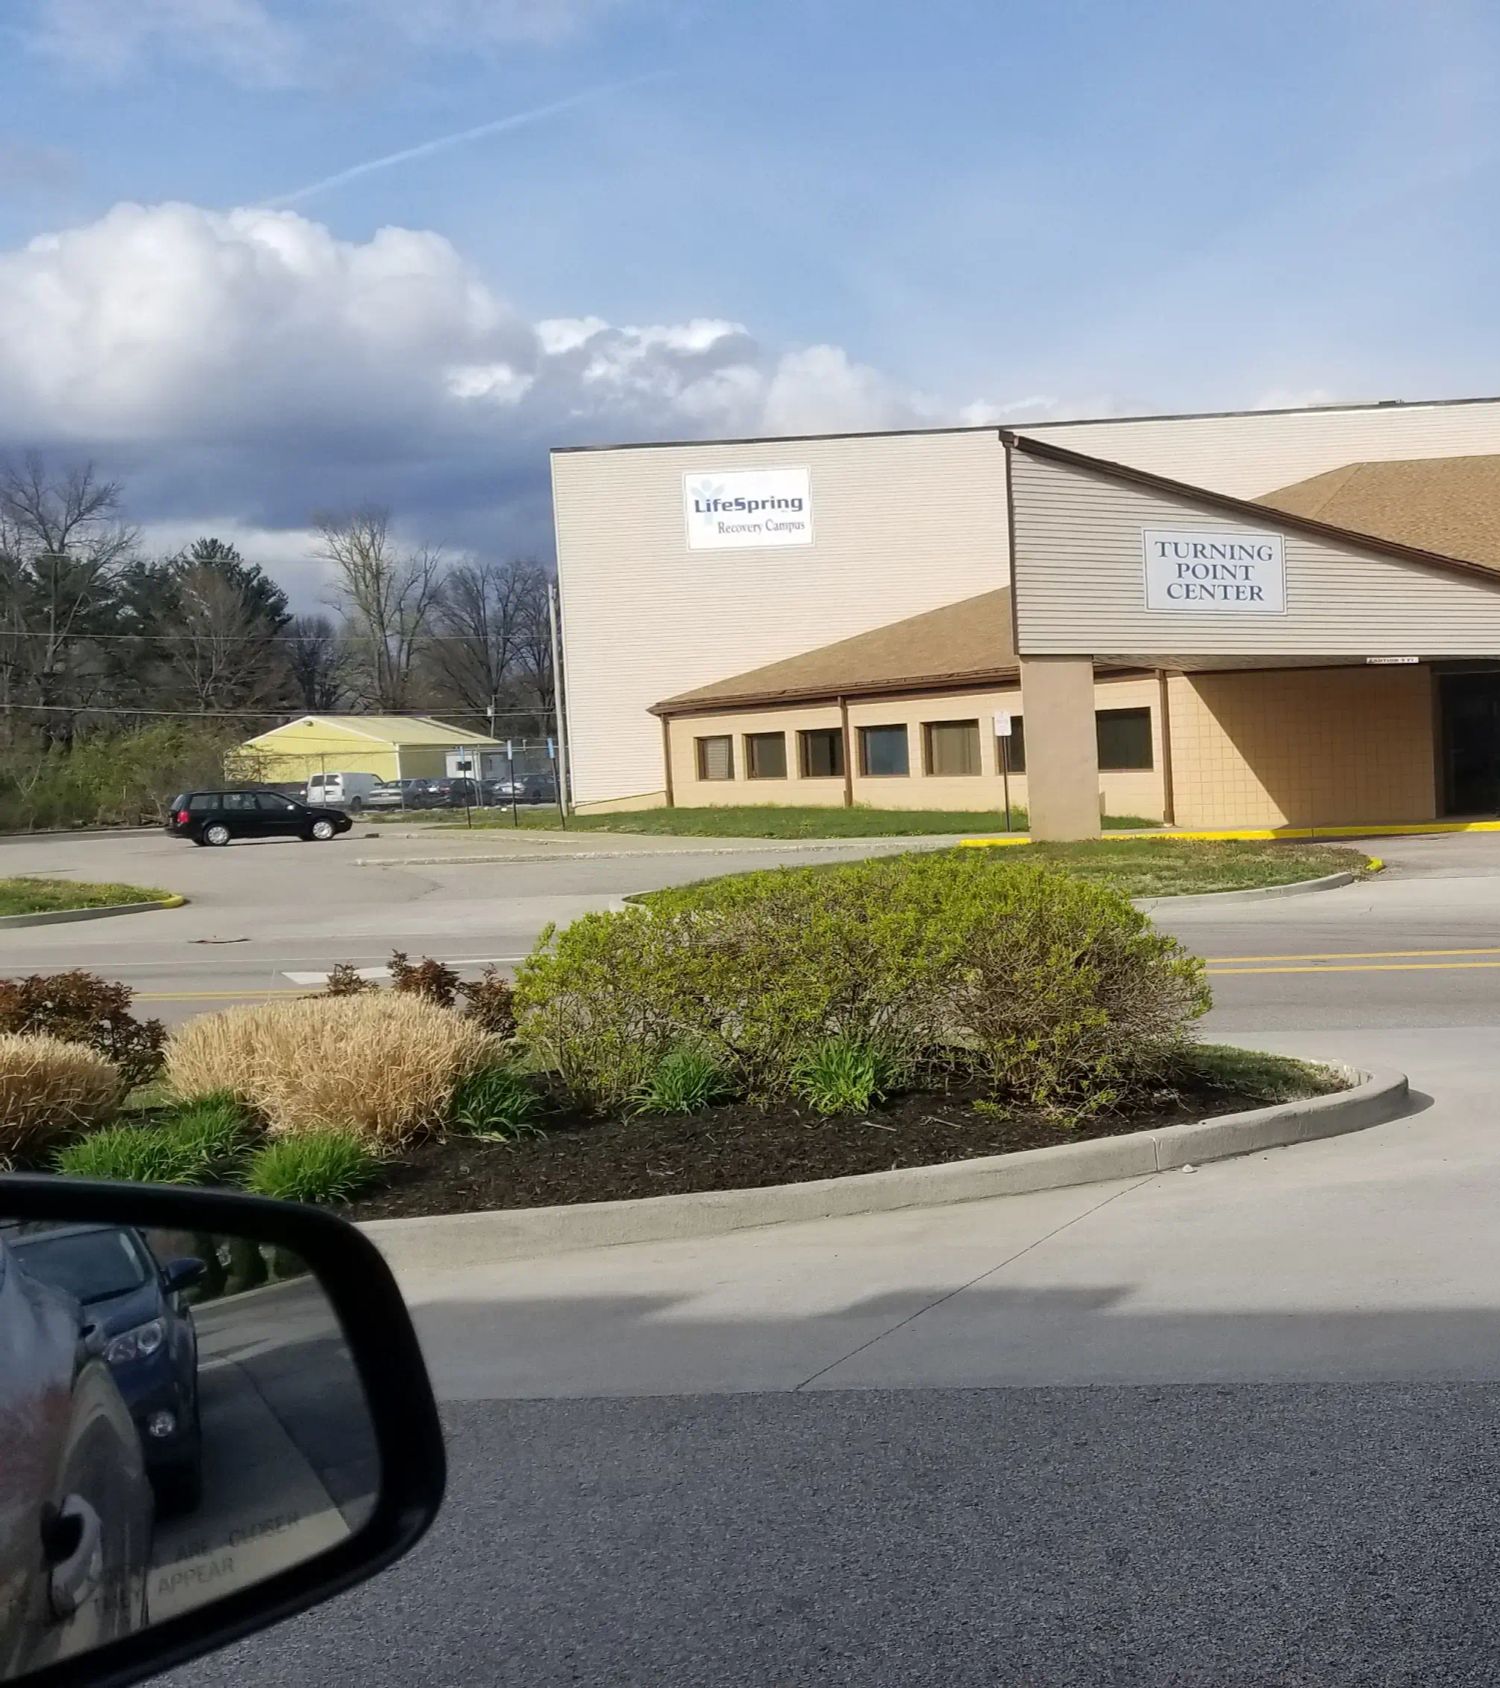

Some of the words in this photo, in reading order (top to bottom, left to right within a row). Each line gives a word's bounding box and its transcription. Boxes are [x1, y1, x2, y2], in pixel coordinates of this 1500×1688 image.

[694, 496, 803, 514] LifeSpring
[718, 521, 762, 534] Recovery
[765, 518, 806, 533] Campus
[1155, 541, 1273, 561] TURNING
[1176, 562, 1255, 581] POINT
[1166, 582, 1264, 601] CENTER
[158, 1555, 235, 1595] APPEAR
